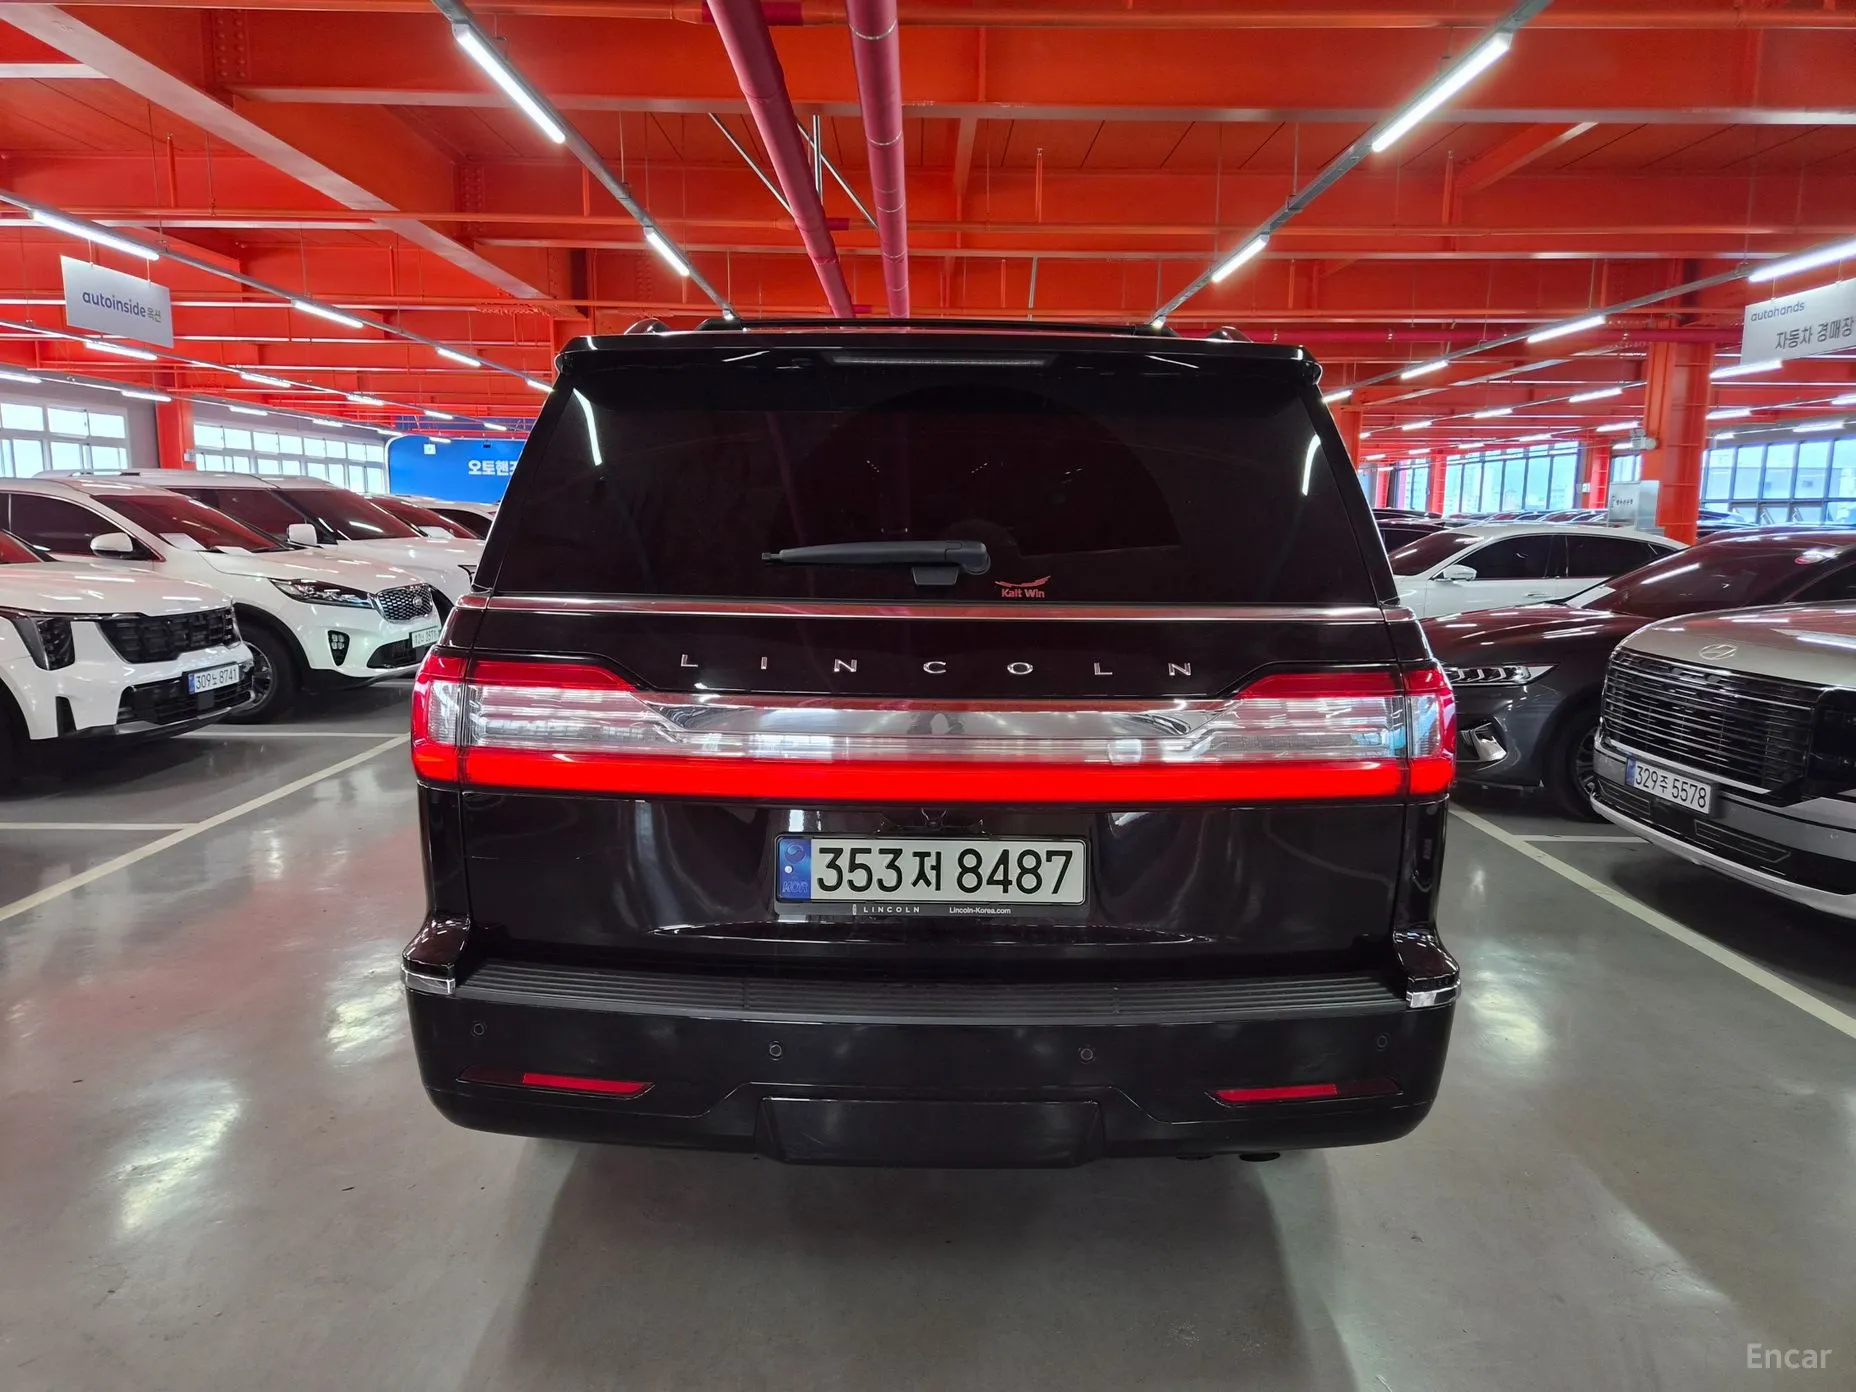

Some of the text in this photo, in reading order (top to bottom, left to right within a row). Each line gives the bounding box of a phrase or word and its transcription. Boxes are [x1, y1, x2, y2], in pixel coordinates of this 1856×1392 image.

[82, 291, 146, 318] autoinside
[1751, 301, 1805, 322] autohands
[1774, 316, 1855, 349] 자동차 경매장
[1024, 588, 1045, 598] Win
[680, 653, 1192, 677] LINCOLN
[195, 668, 236, 690] 309노 8741
[1635, 765, 1707, 808] 329주 5578
[816, 847, 1073, 894] 353저 8487
[949, 906, 1011, 914] Lincoln-Korea.com
